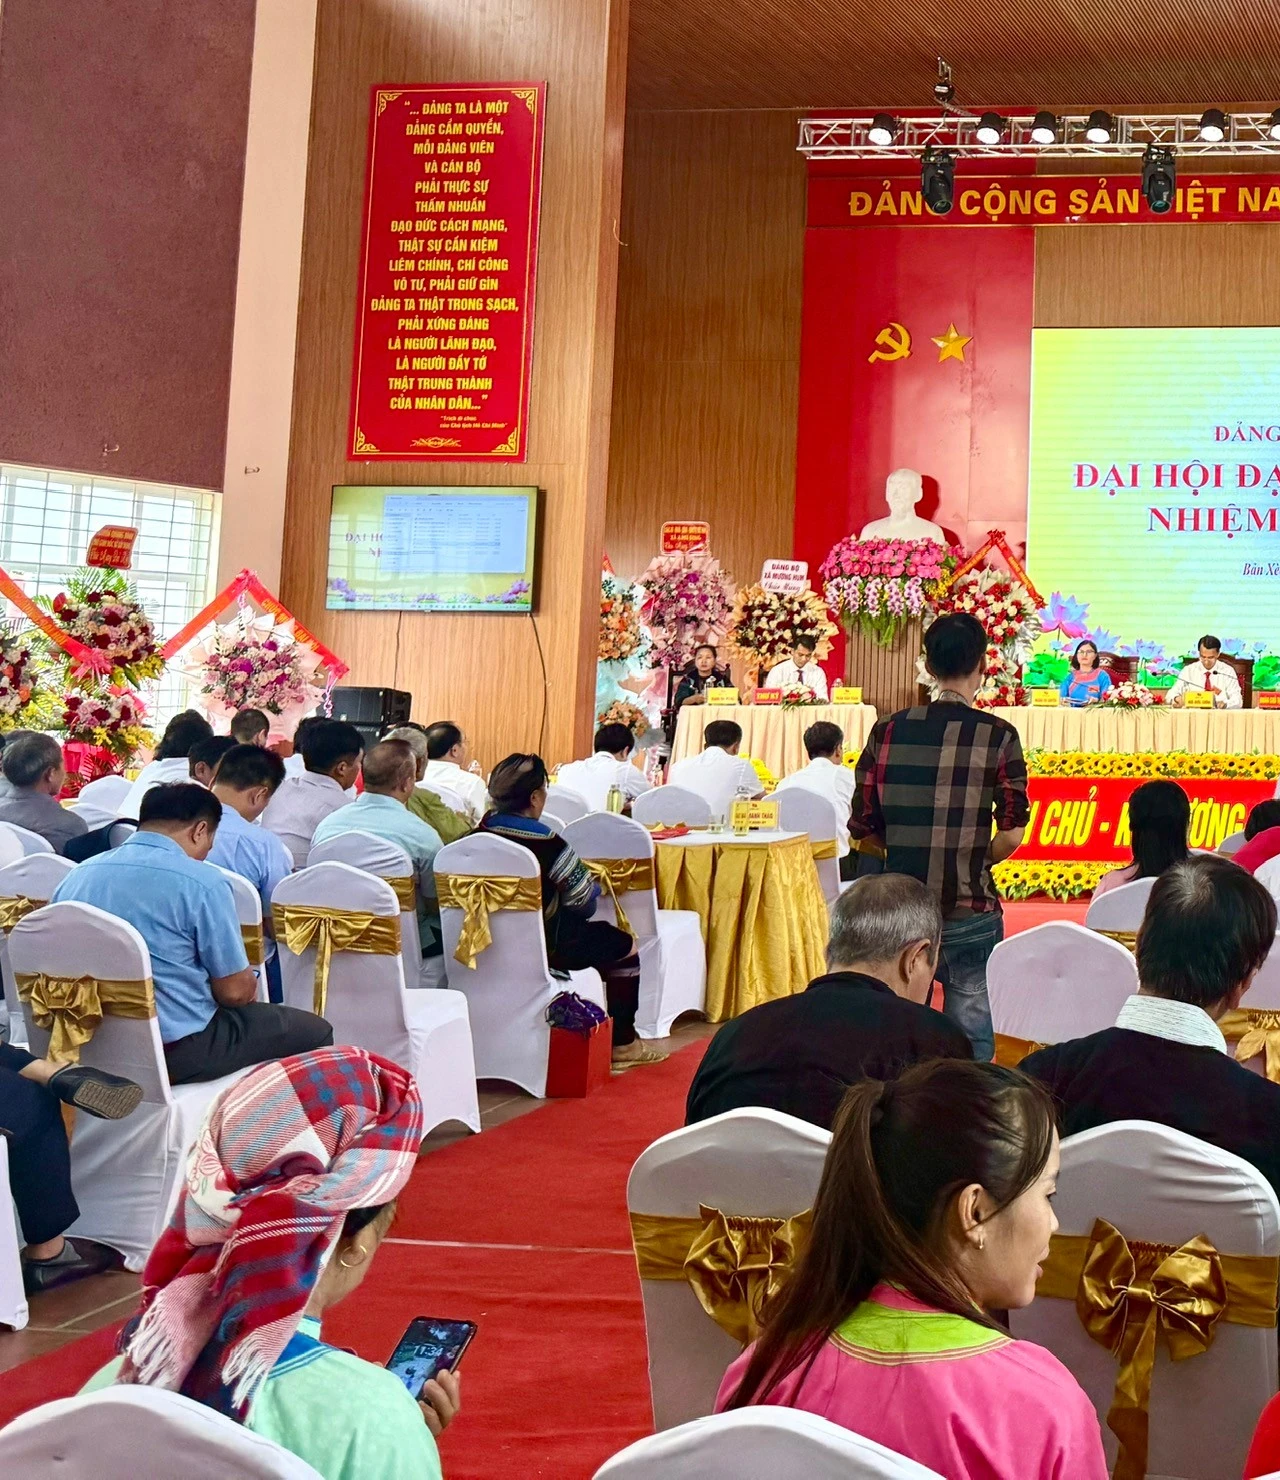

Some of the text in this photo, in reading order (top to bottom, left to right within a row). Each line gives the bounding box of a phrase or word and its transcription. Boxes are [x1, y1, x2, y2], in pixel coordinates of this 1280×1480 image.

[422, 99, 509, 116] ĐẢNG TA LÀ MỘT
[406, 121, 435, 135] ĐẢNG
[437, 139, 467, 154] ĐẢNG
[424, 158, 481, 175] VÀ CÁN BỘ
[415, 178, 440, 193] PHẢI
[473, 180, 489, 195] SỰ
[959, 182, 1057, 222] CỘNG
[1069, 177, 1139, 214] SẢN
[1175, 179, 1227, 220] IỆT
[391, 221, 413, 234] ĐẠO
[440, 217, 469, 231] CÁCH
[472, 220, 508, 233] MẠNG,
[427, 239, 443, 254] SỰ
[418, 257, 454, 272] CHÍNH,
[457, 256, 476, 271] CHÍ
[411, 278, 426, 292] TƯ,
[429, 276, 455, 290] PHẢI
[371, 295, 401, 311] ĐẢNG
[404, 299, 416, 311] TA
[448, 299, 483, 310] TRONG
[486, 298, 519, 313] SẠCH,
[398, 315, 424, 330] PHẢI
[459, 315, 489, 330] ĐÁNG
[1074, 463, 1142, 496] ĐẠI
[1153, 459, 1224, 496] HỘI
[1147, 502, 1279, 539] NHIỆM
[1243, 562, 1263, 576] Bản
[1039, 785, 1098, 847] CHỦ
[413, 1345, 444, 1357] 11:34
